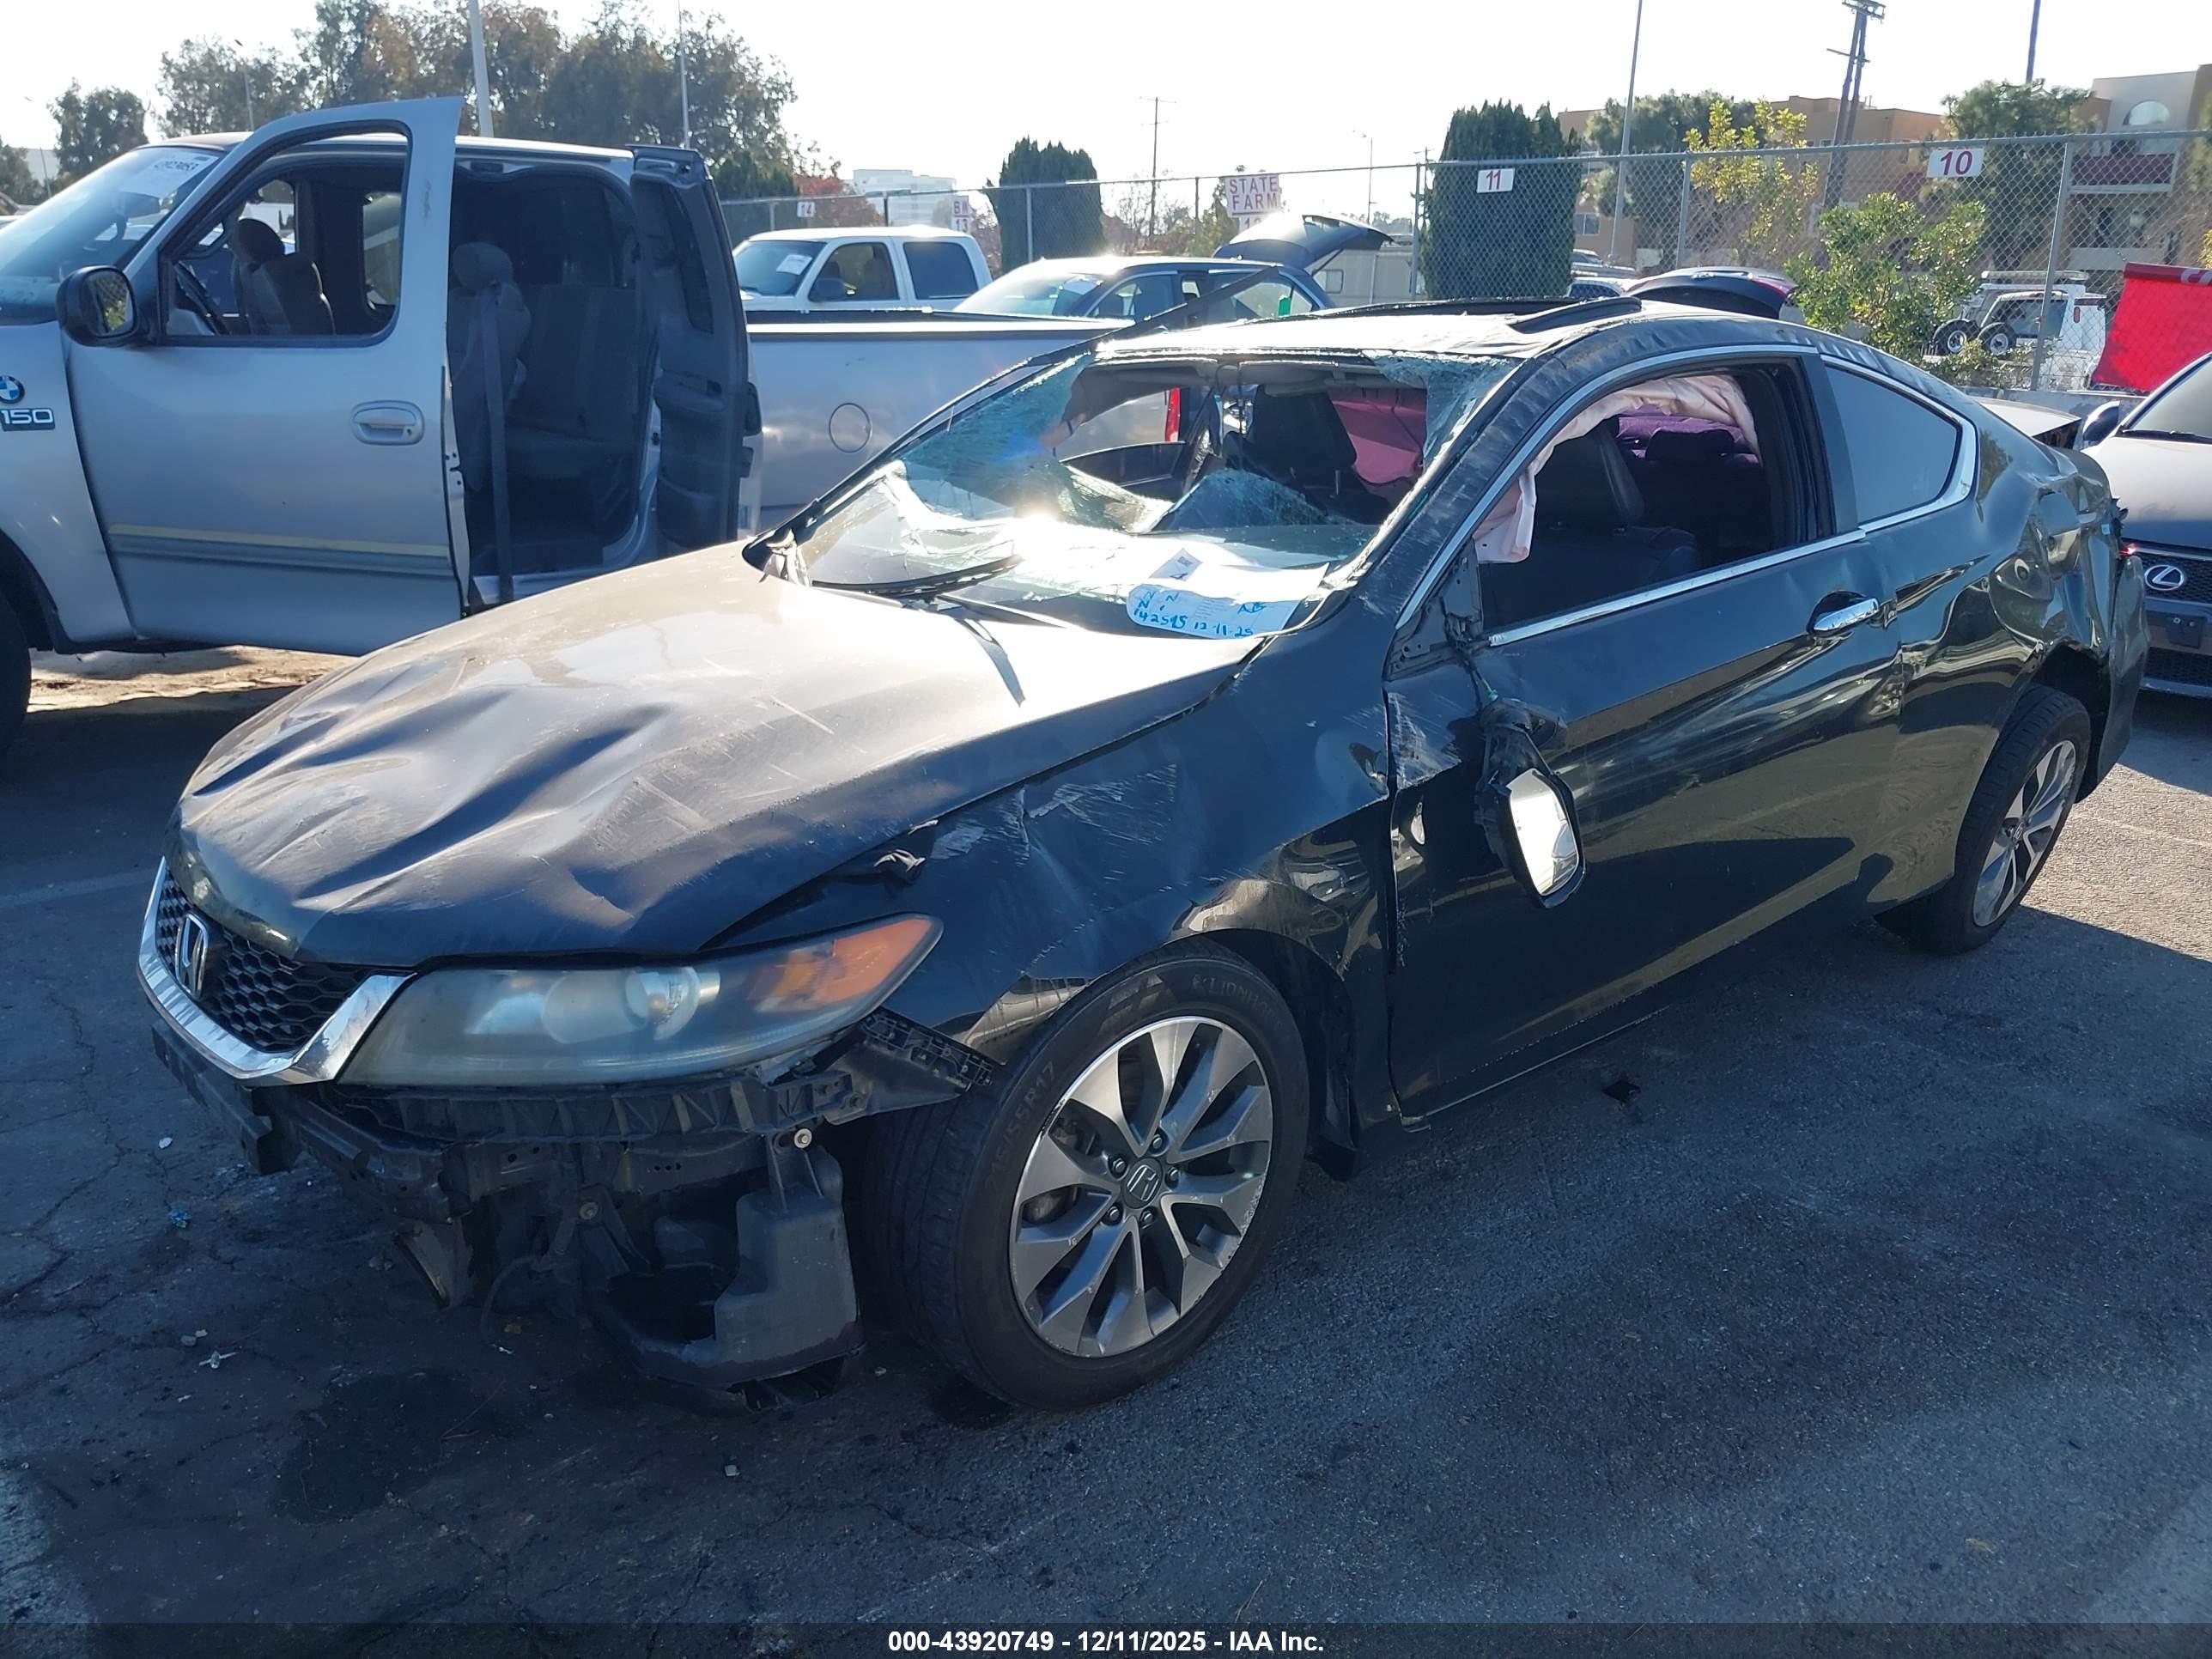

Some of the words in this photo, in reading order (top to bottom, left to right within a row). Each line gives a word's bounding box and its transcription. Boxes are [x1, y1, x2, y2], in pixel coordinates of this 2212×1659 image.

[1940, 150, 1972, 176] 10
[1229, 176, 1278, 194] STATE
[1486, 169, 1501, 191] 11
[1232, 192, 1278, 210] FARM
[956, 218, 969, 233] 13
[1, 409, 53, 424] 150
